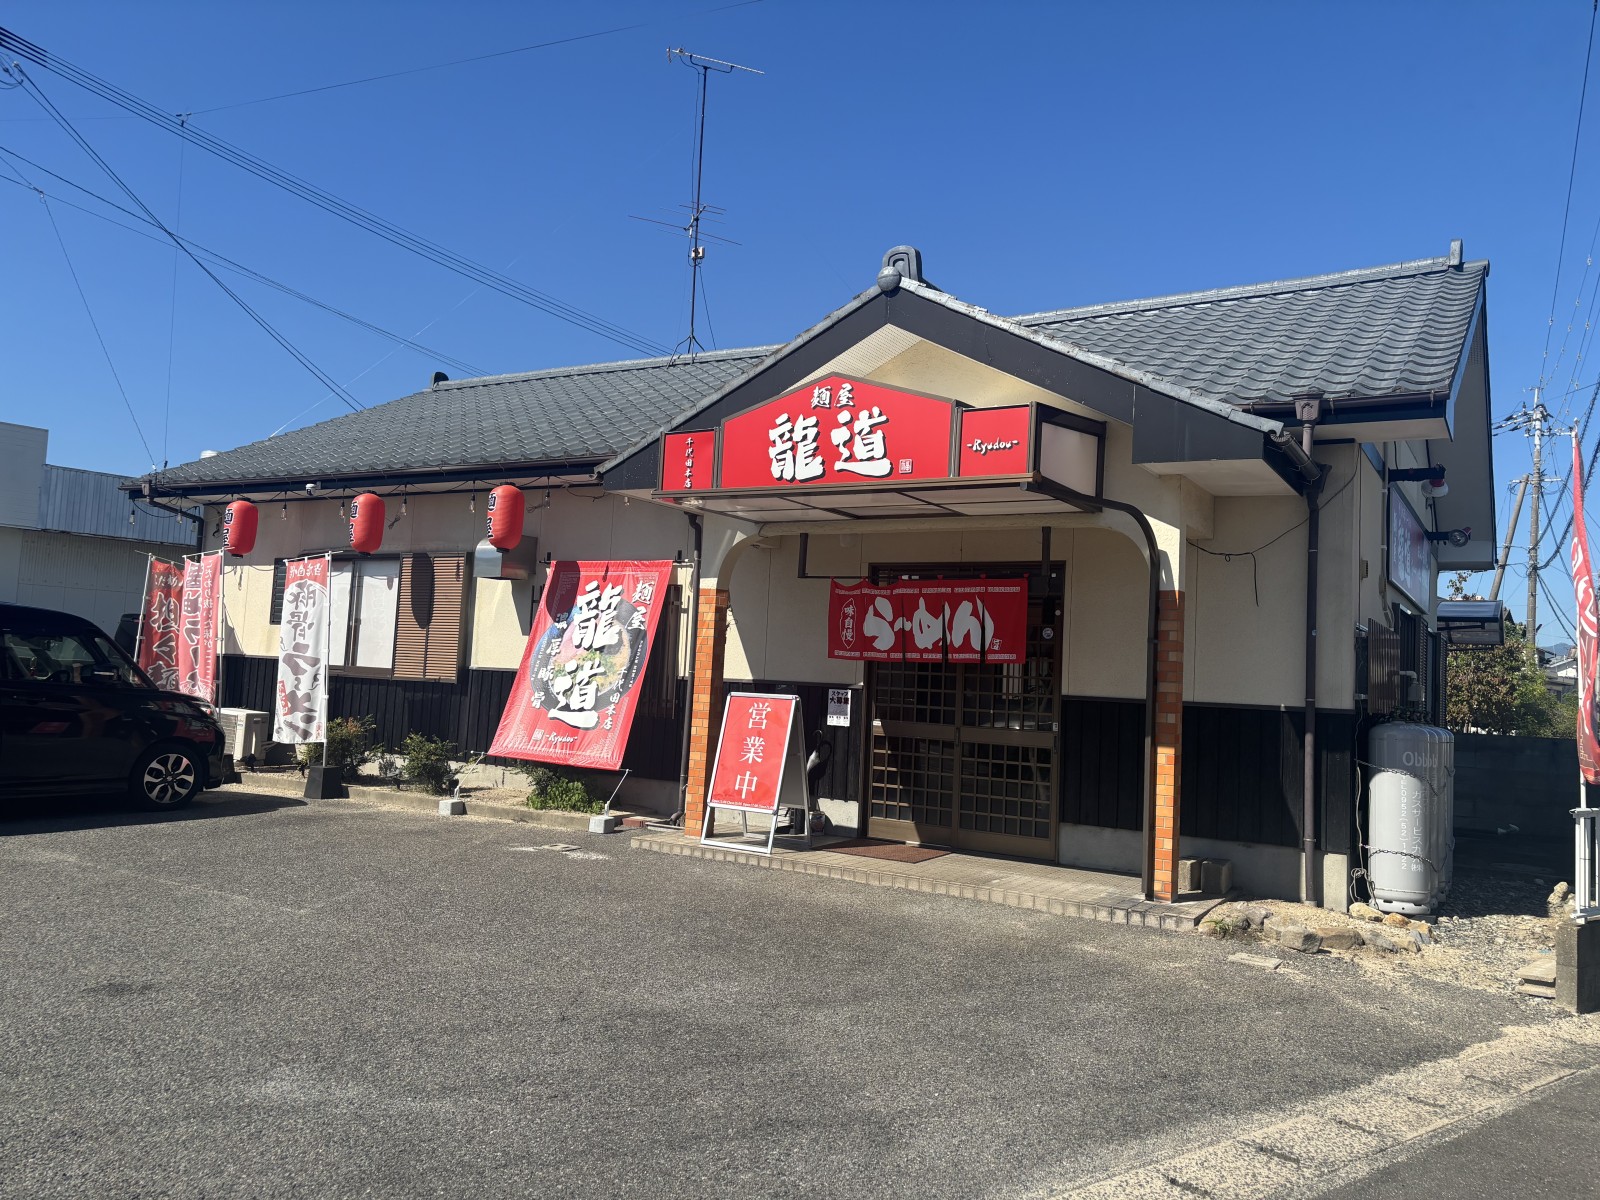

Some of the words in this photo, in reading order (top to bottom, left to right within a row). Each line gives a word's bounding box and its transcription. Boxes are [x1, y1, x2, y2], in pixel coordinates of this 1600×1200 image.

[810, 383, 855, 408] 麺屋
[683, 437, 694, 488] 千代田本店
[768, 407, 892, 481] 龍道
[841, 604, 856, 643] 味自慢
[863, 594, 994, 651] らーめん
[548, 580, 624, 730] 龍道
[735, 702, 772, 799] 営業中
